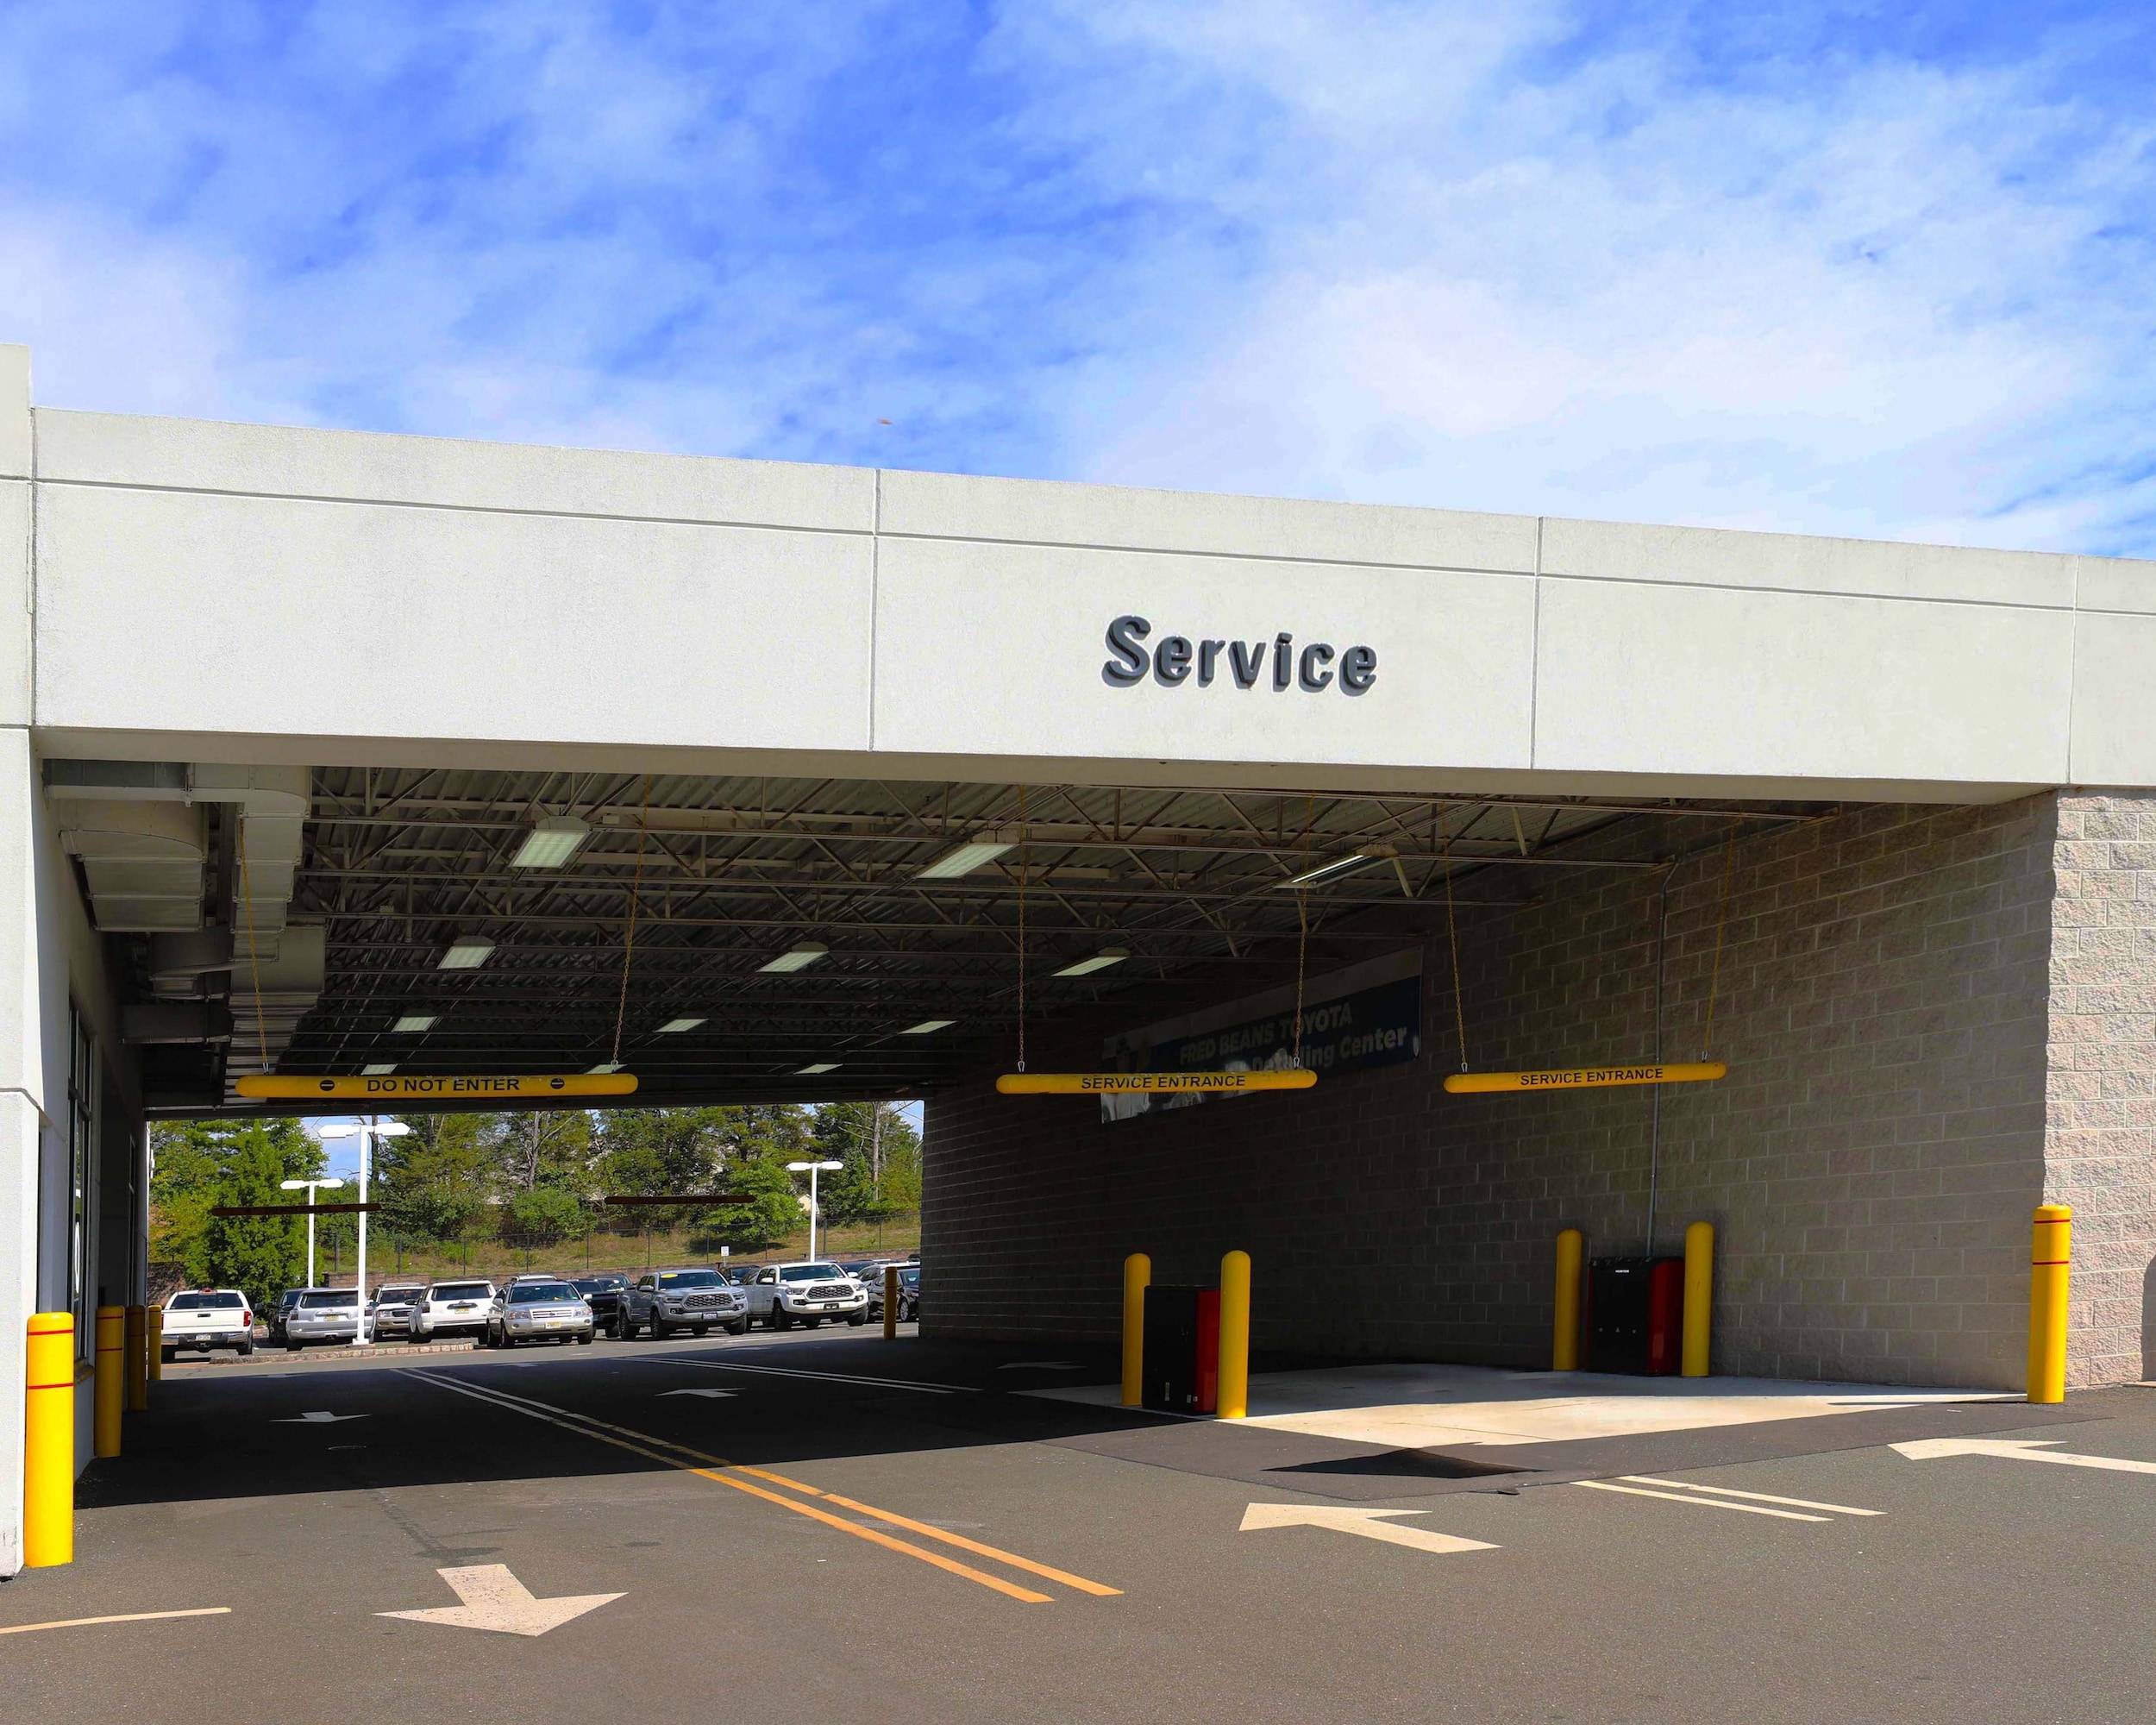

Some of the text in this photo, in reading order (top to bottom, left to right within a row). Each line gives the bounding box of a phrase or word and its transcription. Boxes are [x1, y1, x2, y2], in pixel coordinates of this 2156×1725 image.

[1102, 615, 1377, 696] Service
[1179, 1002, 1353, 1065] FRED BEANS TOYOTA
[1338, 1026, 1407, 1059] Center
[367, 1078, 520, 1092] DO NOT ENTER
[1081, 1075, 1246, 1089] SERVICE ENTRANCE
[1520, 1068, 1664, 1086] SERVICE ENTRANCE
